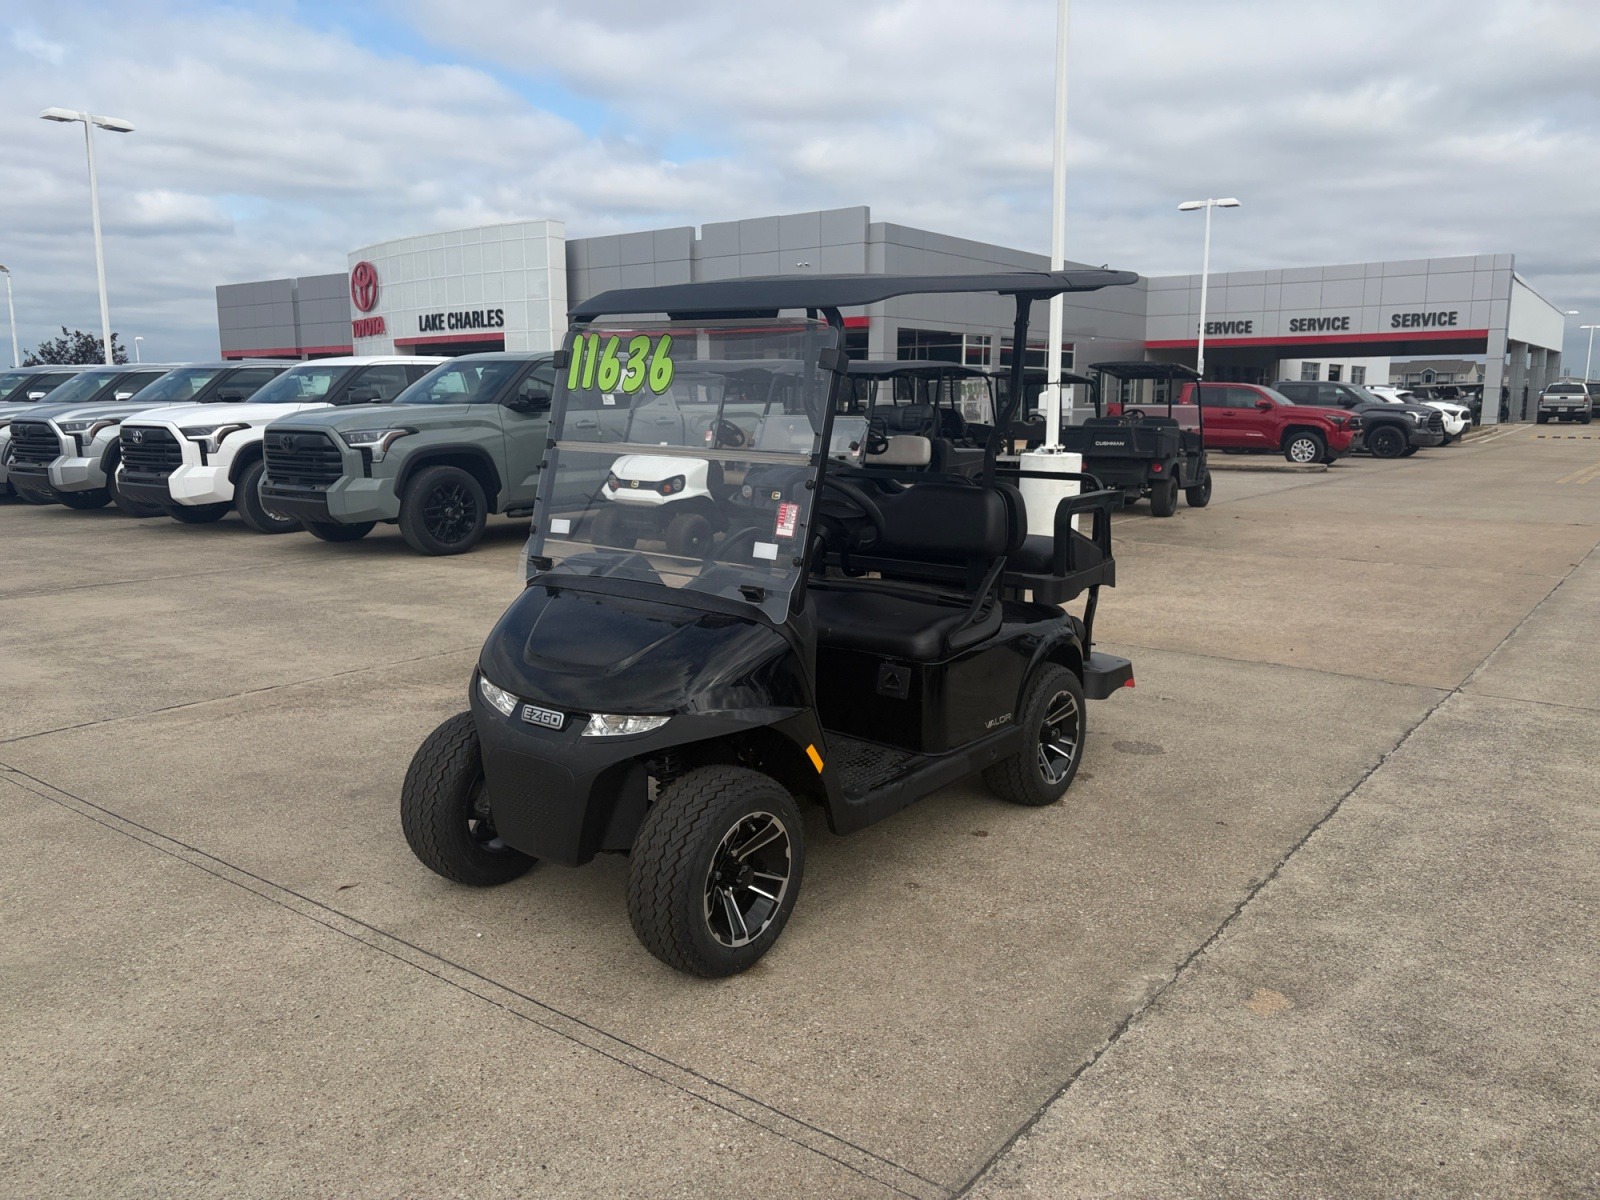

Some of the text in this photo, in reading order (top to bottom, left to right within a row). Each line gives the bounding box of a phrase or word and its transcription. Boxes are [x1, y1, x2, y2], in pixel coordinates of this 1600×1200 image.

[352, 316, 386, 338] TOYOTA
[418, 308, 504, 332] LAKE CHARLES
[1289, 316, 1350, 332] SERVICE
[1390, 311, 1458, 328] SERVICE
[567, 333, 675, 395] 11636
[985, 713, 1012, 729] VALOR
